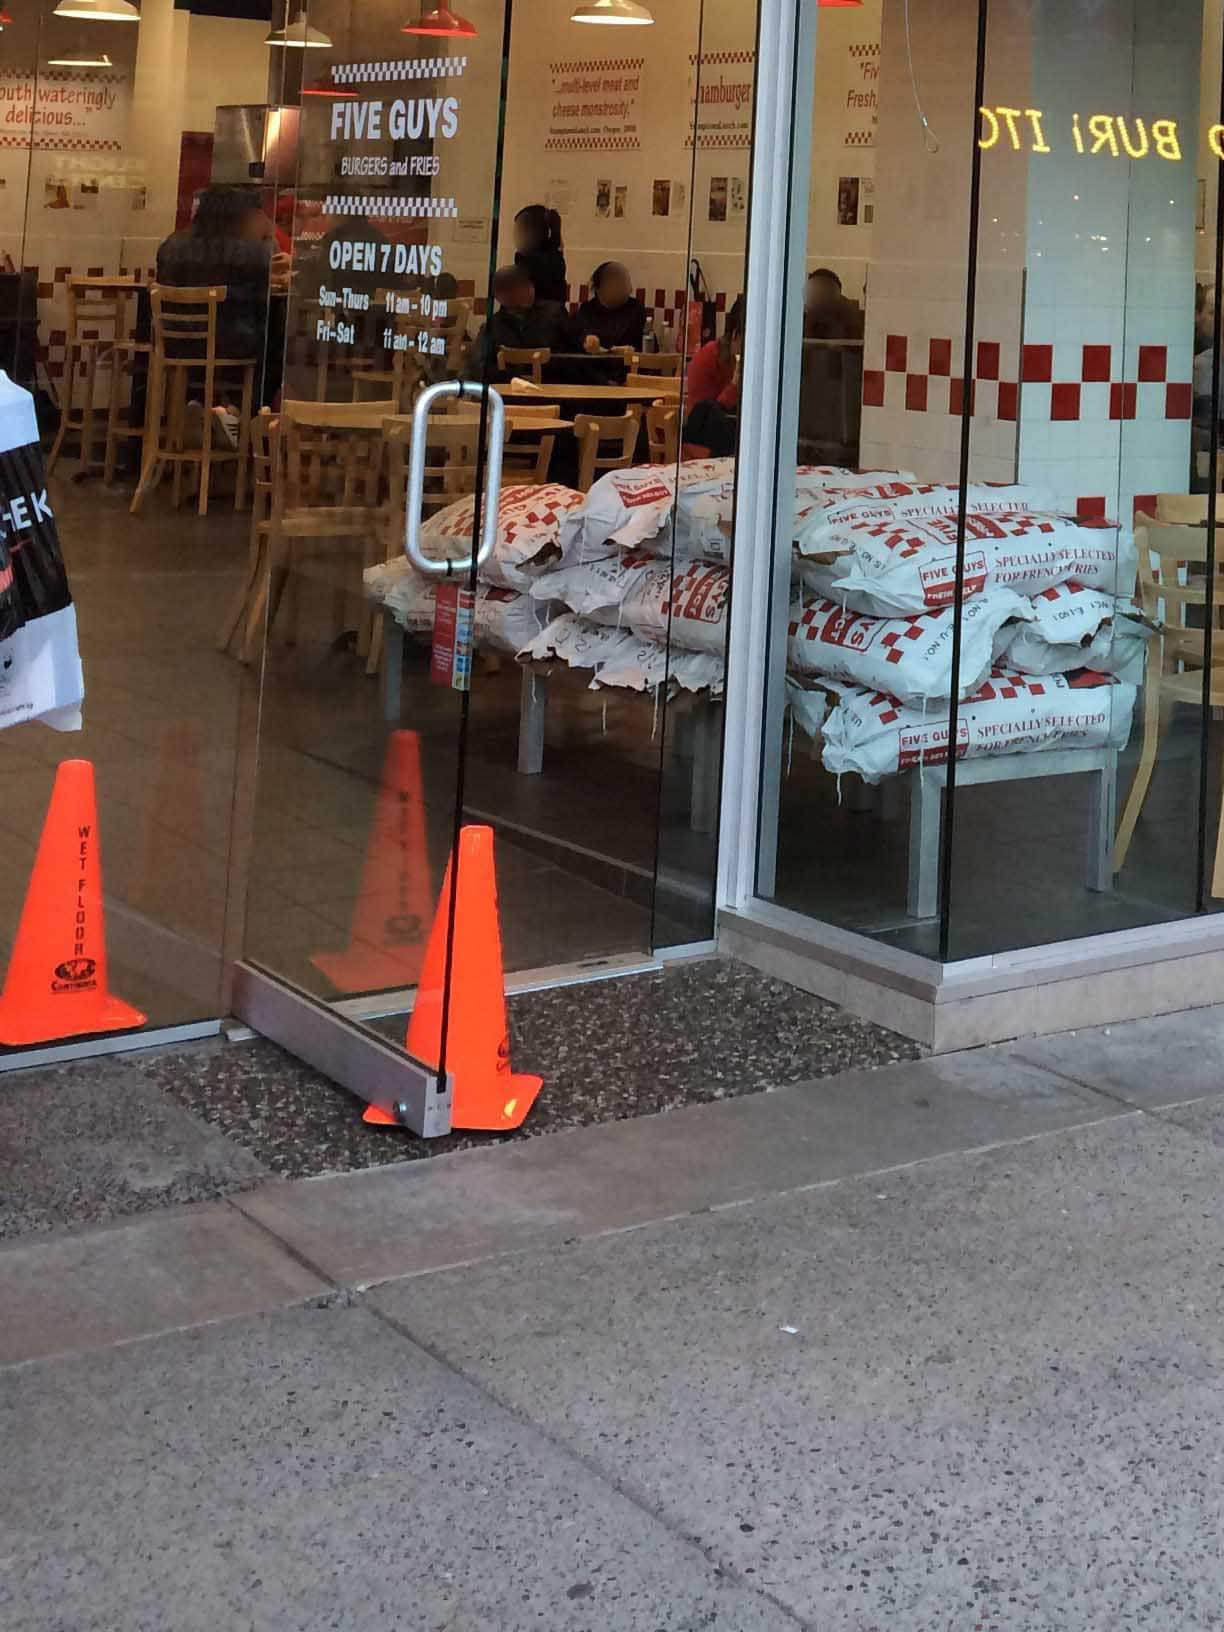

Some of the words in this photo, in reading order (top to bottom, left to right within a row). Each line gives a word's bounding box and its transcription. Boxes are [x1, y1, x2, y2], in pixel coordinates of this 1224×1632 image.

[38, 86, 116, 110] wateringly
[330, 100, 383, 141] FIVE
[388, 96, 459, 141] GUYS
[340, 156, 388, 177] BURGERS
[389, 156, 408, 177] and
[409, 155, 440, 177] FRIES
[329, 240, 376, 273] OPEN
[380, 244, 391, 273] 7
[393, 244, 443, 278] DAYS
[385, 291, 395, 313] 11
[396, 297, 410, 314] am
[420, 293, 431, 317] 10
[431, 299, 448, 321] pm
[429, 336, 446, 356] am
[923, 567, 948, 582] FIVE
[932, 727, 969, 742] GUS
[78, 825, 91, 870] WET
